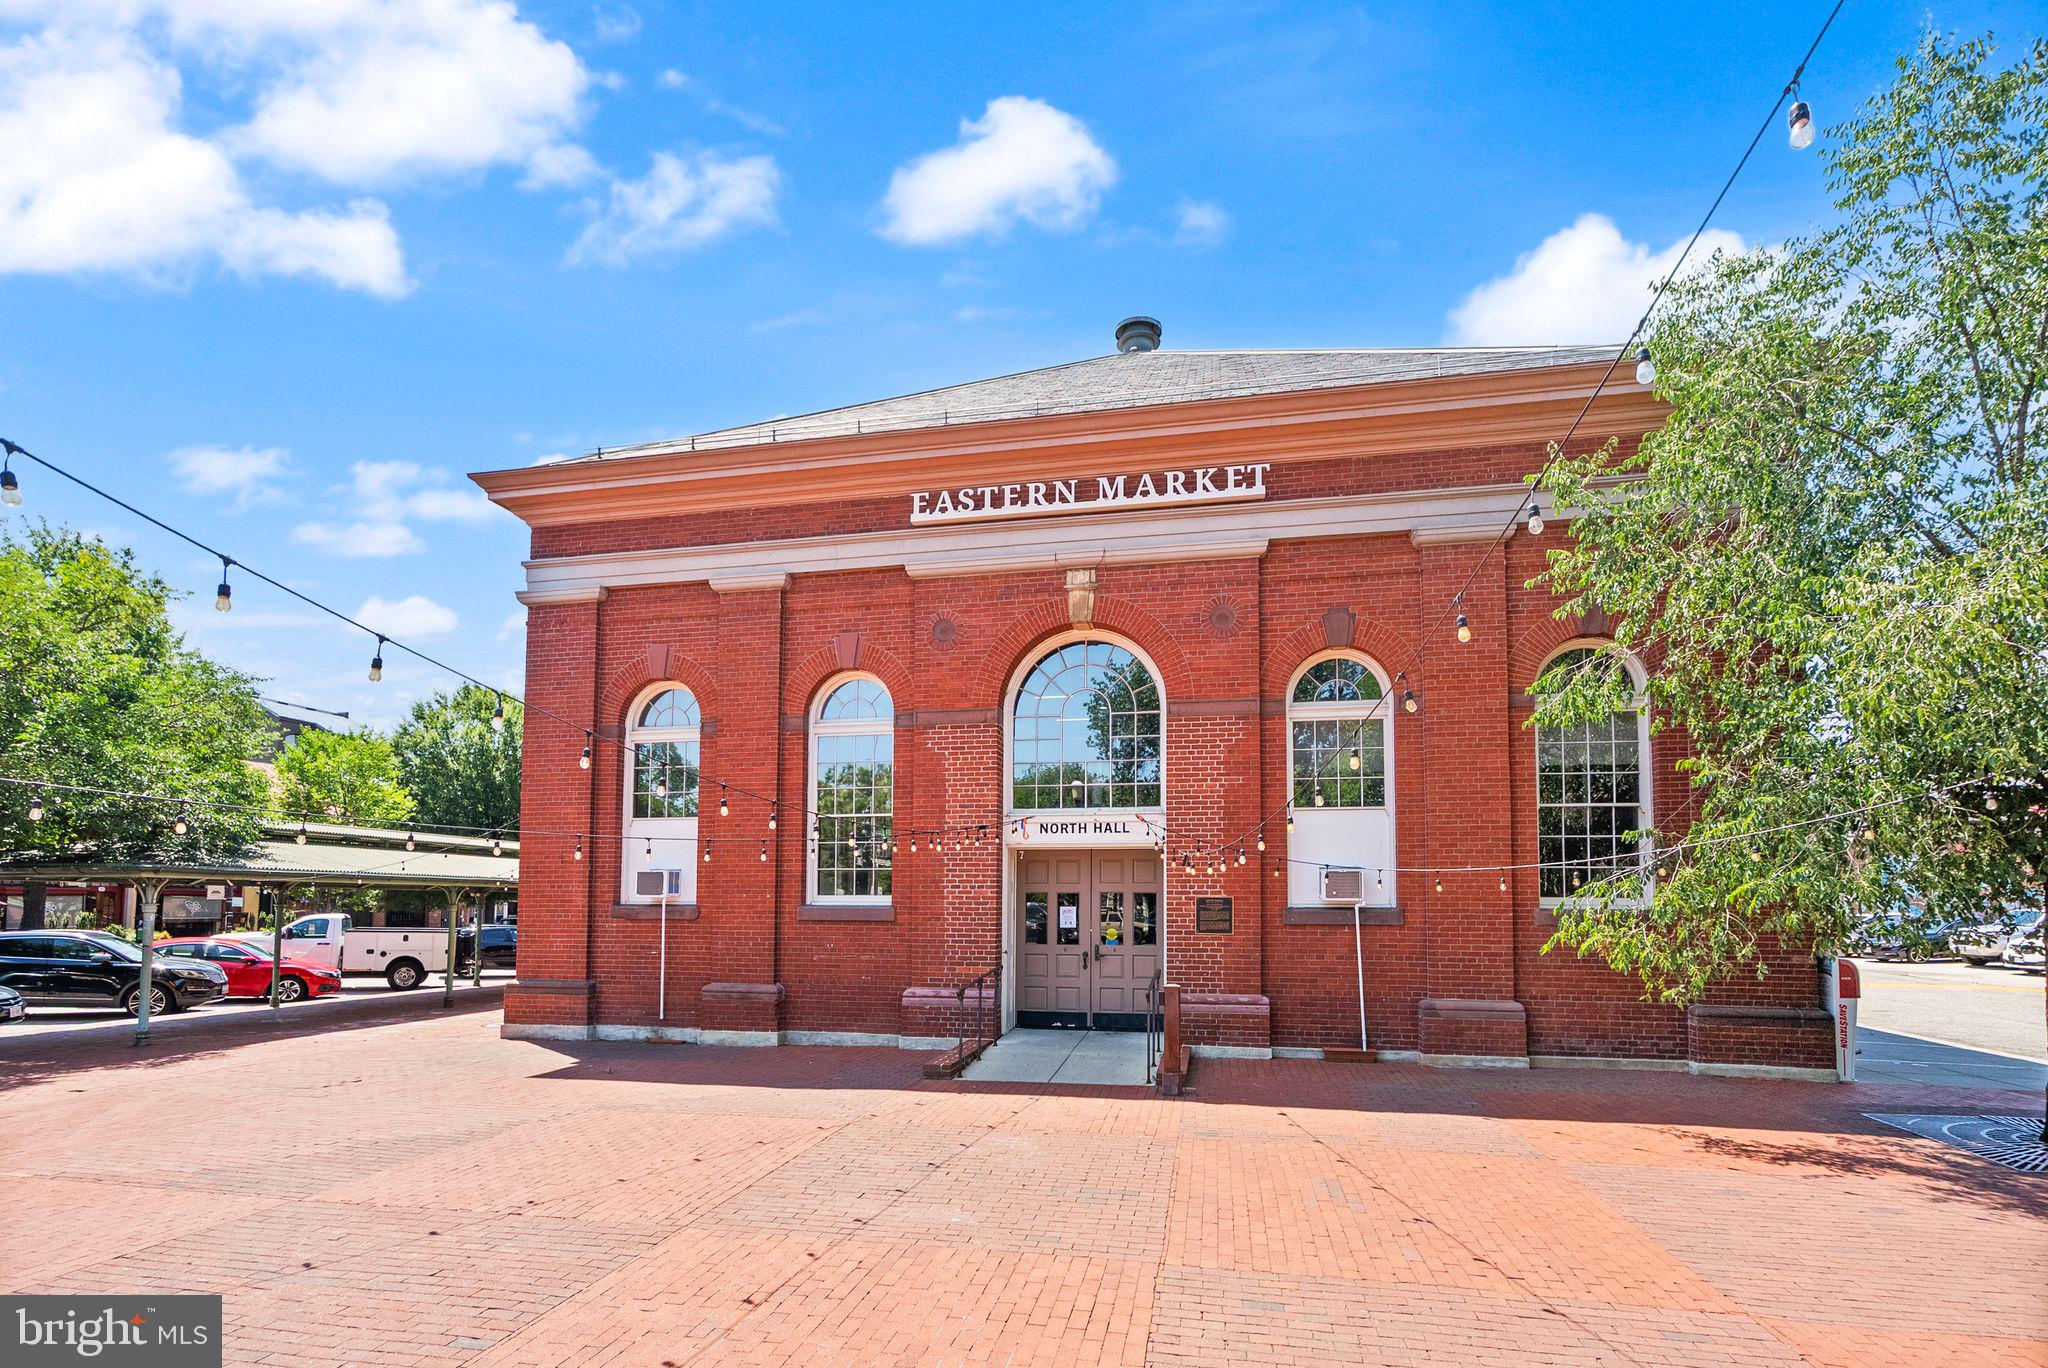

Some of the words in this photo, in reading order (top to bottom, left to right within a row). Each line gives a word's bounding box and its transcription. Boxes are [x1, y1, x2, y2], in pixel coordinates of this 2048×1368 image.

[911, 480, 1079, 516] EASTERN
[1096, 464, 1271, 501] MARKET
[1039, 822, 1087, 834] NORTH
[1093, 822, 1130, 834] HALL
